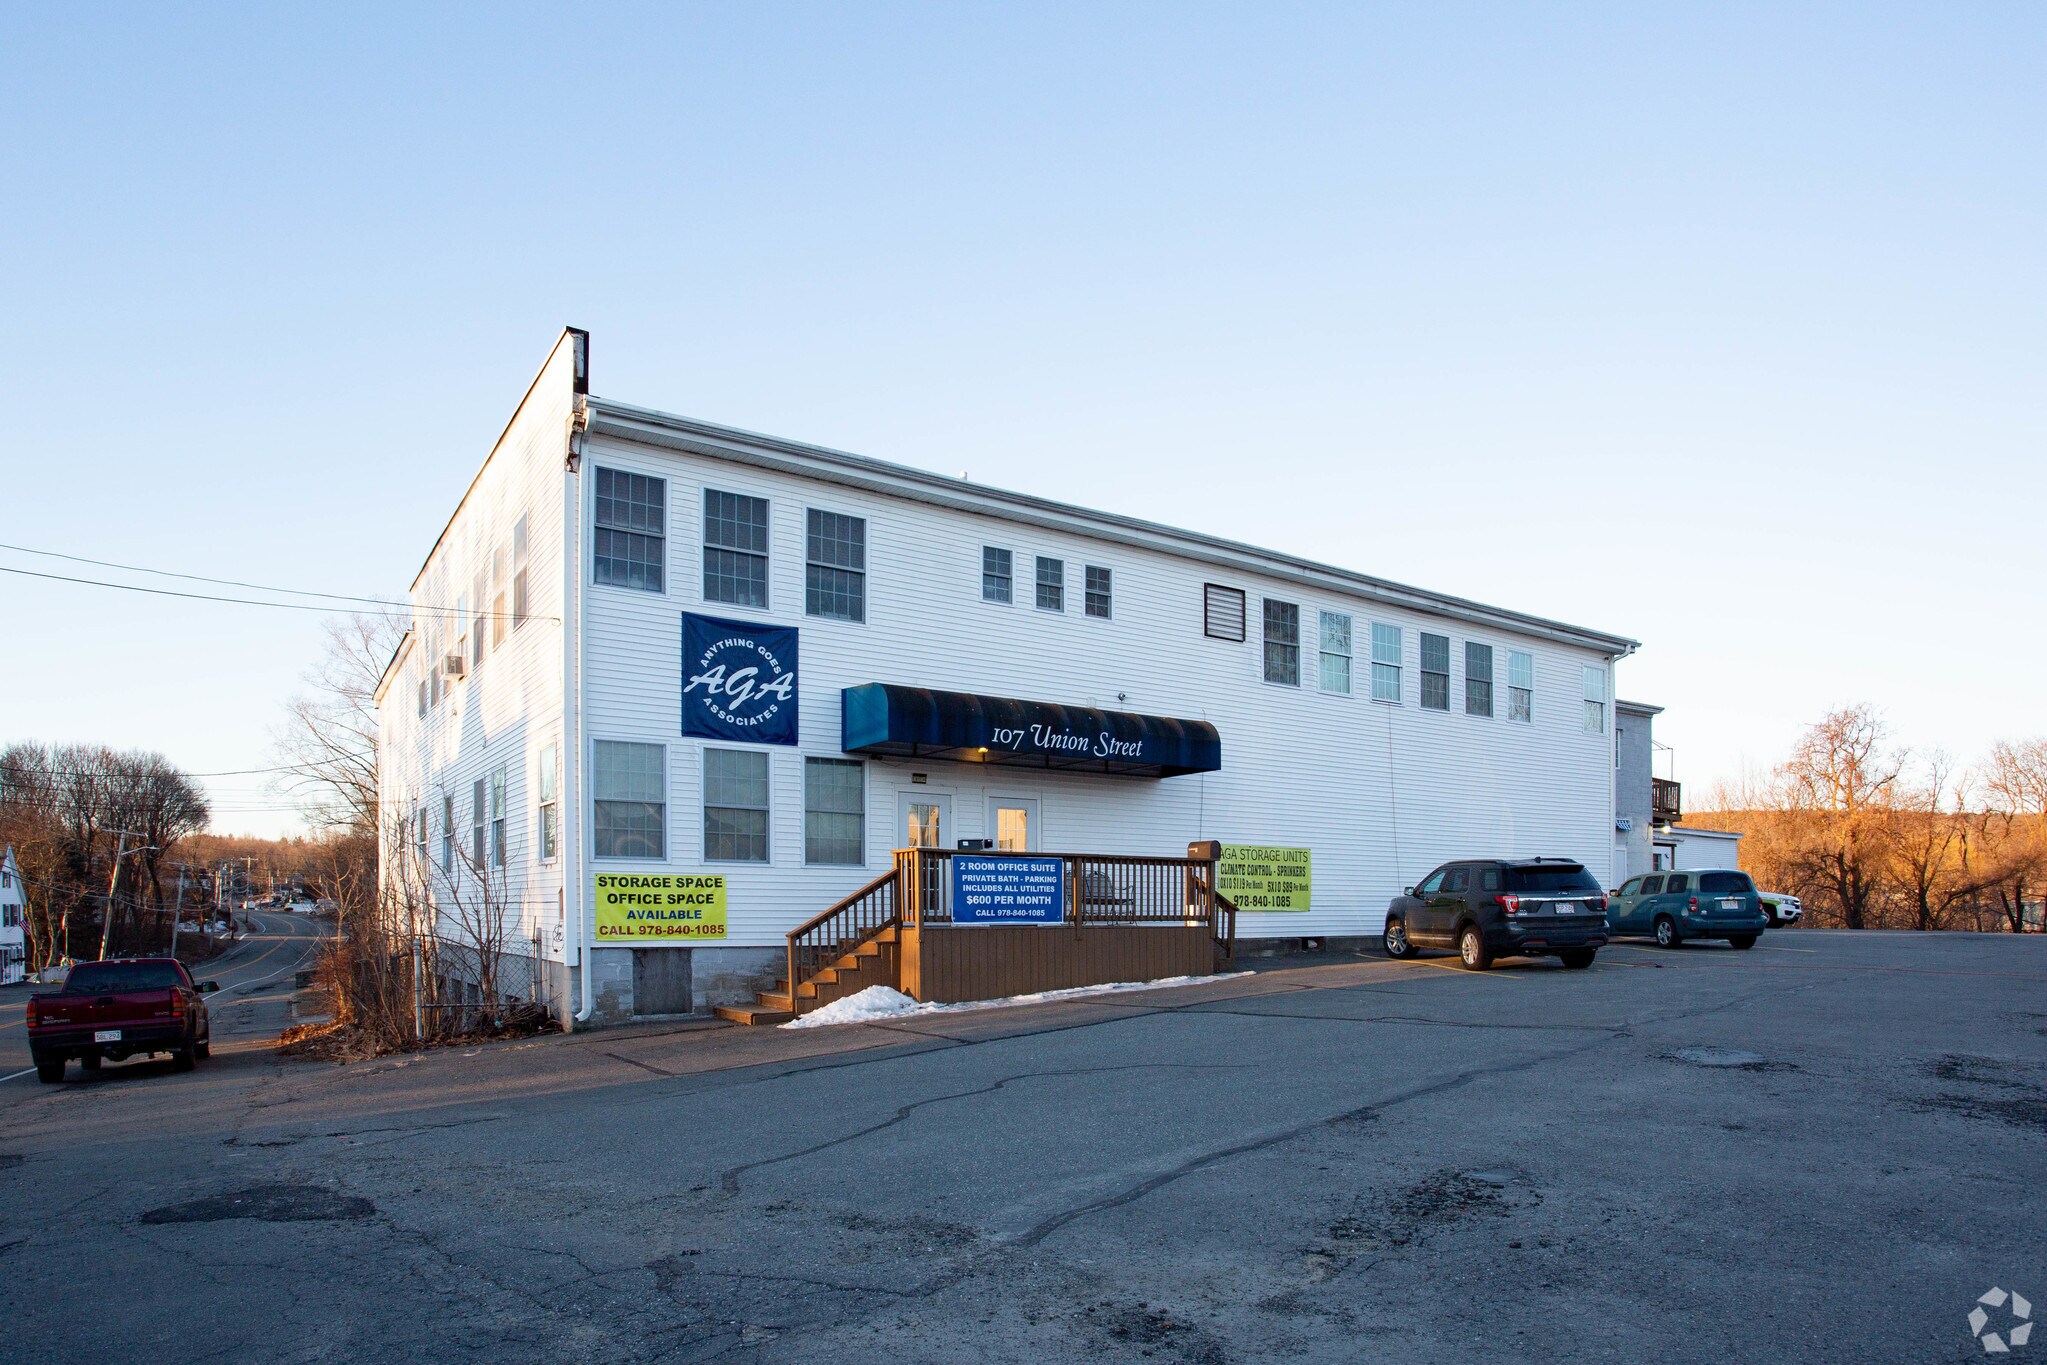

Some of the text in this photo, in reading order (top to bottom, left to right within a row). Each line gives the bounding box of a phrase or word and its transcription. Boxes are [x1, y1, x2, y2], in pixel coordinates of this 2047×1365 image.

[700, 638, 782, 675] ANYTHING GOES
[683, 664, 794, 711] AGA
[703, 697, 778, 726] ASSOCIATES
[991, 723, 1143, 757] 107 Union Street
[1240, 848, 1281, 862] STORAGE
[1282, 850, 1308, 863] UNITS
[960, 862, 1056, 872] 2 ROOM OFFICE SUITE
[1220, 863, 1246, 876] CLIMATE
[1247, 864, 1272, 877] CONTROL
[598, 876, 723, 888] STORAGE SPACE
[962, 874, 997, 882] PRIVATE
[997, 875, 1019, 883] BATH
[1020, 885, 1055, 893] UTILITIES
[607, 893, 714, 904] OFFICE SPACE
[966, 895, 1052, 905] $600 PER MONTH
[1233, 895, 1291, 907] 978-840-1085
[627, 910, 702, 920] AVAILABLE
[997, 909, 1045, 917] 978-840-1085
[599, 924, 725, 935] CALL 978-840-1085
